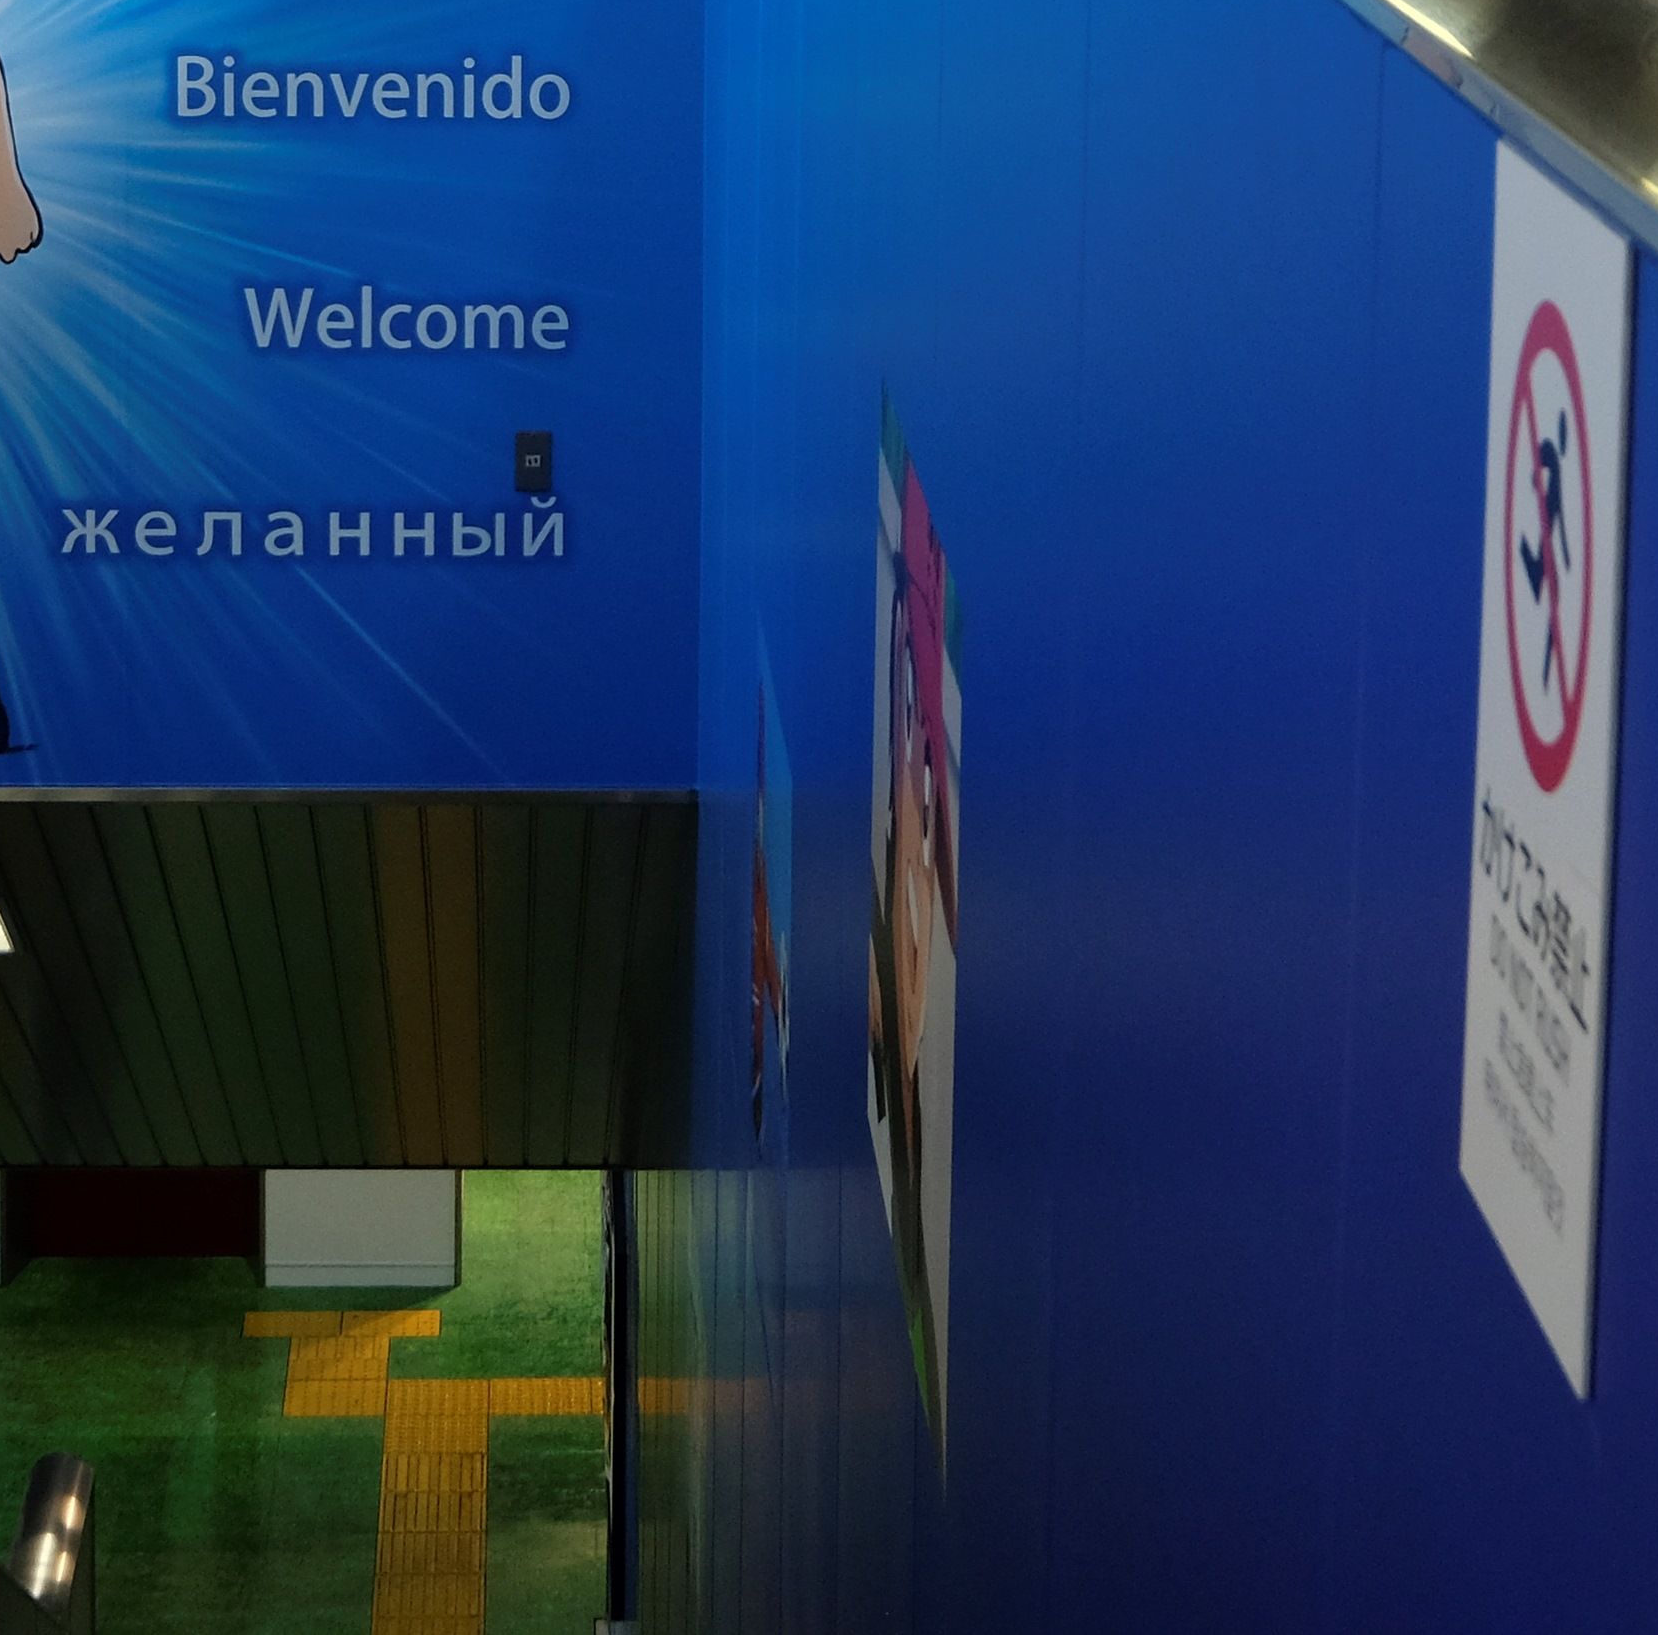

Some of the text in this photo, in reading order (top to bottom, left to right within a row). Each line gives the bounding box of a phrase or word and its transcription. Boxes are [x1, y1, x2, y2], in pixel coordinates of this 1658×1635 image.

[175, 55, 572, 120] Bienvenido
[242, 284, 570, 350] Welcome
[61, 495, 564, 557] желанный
